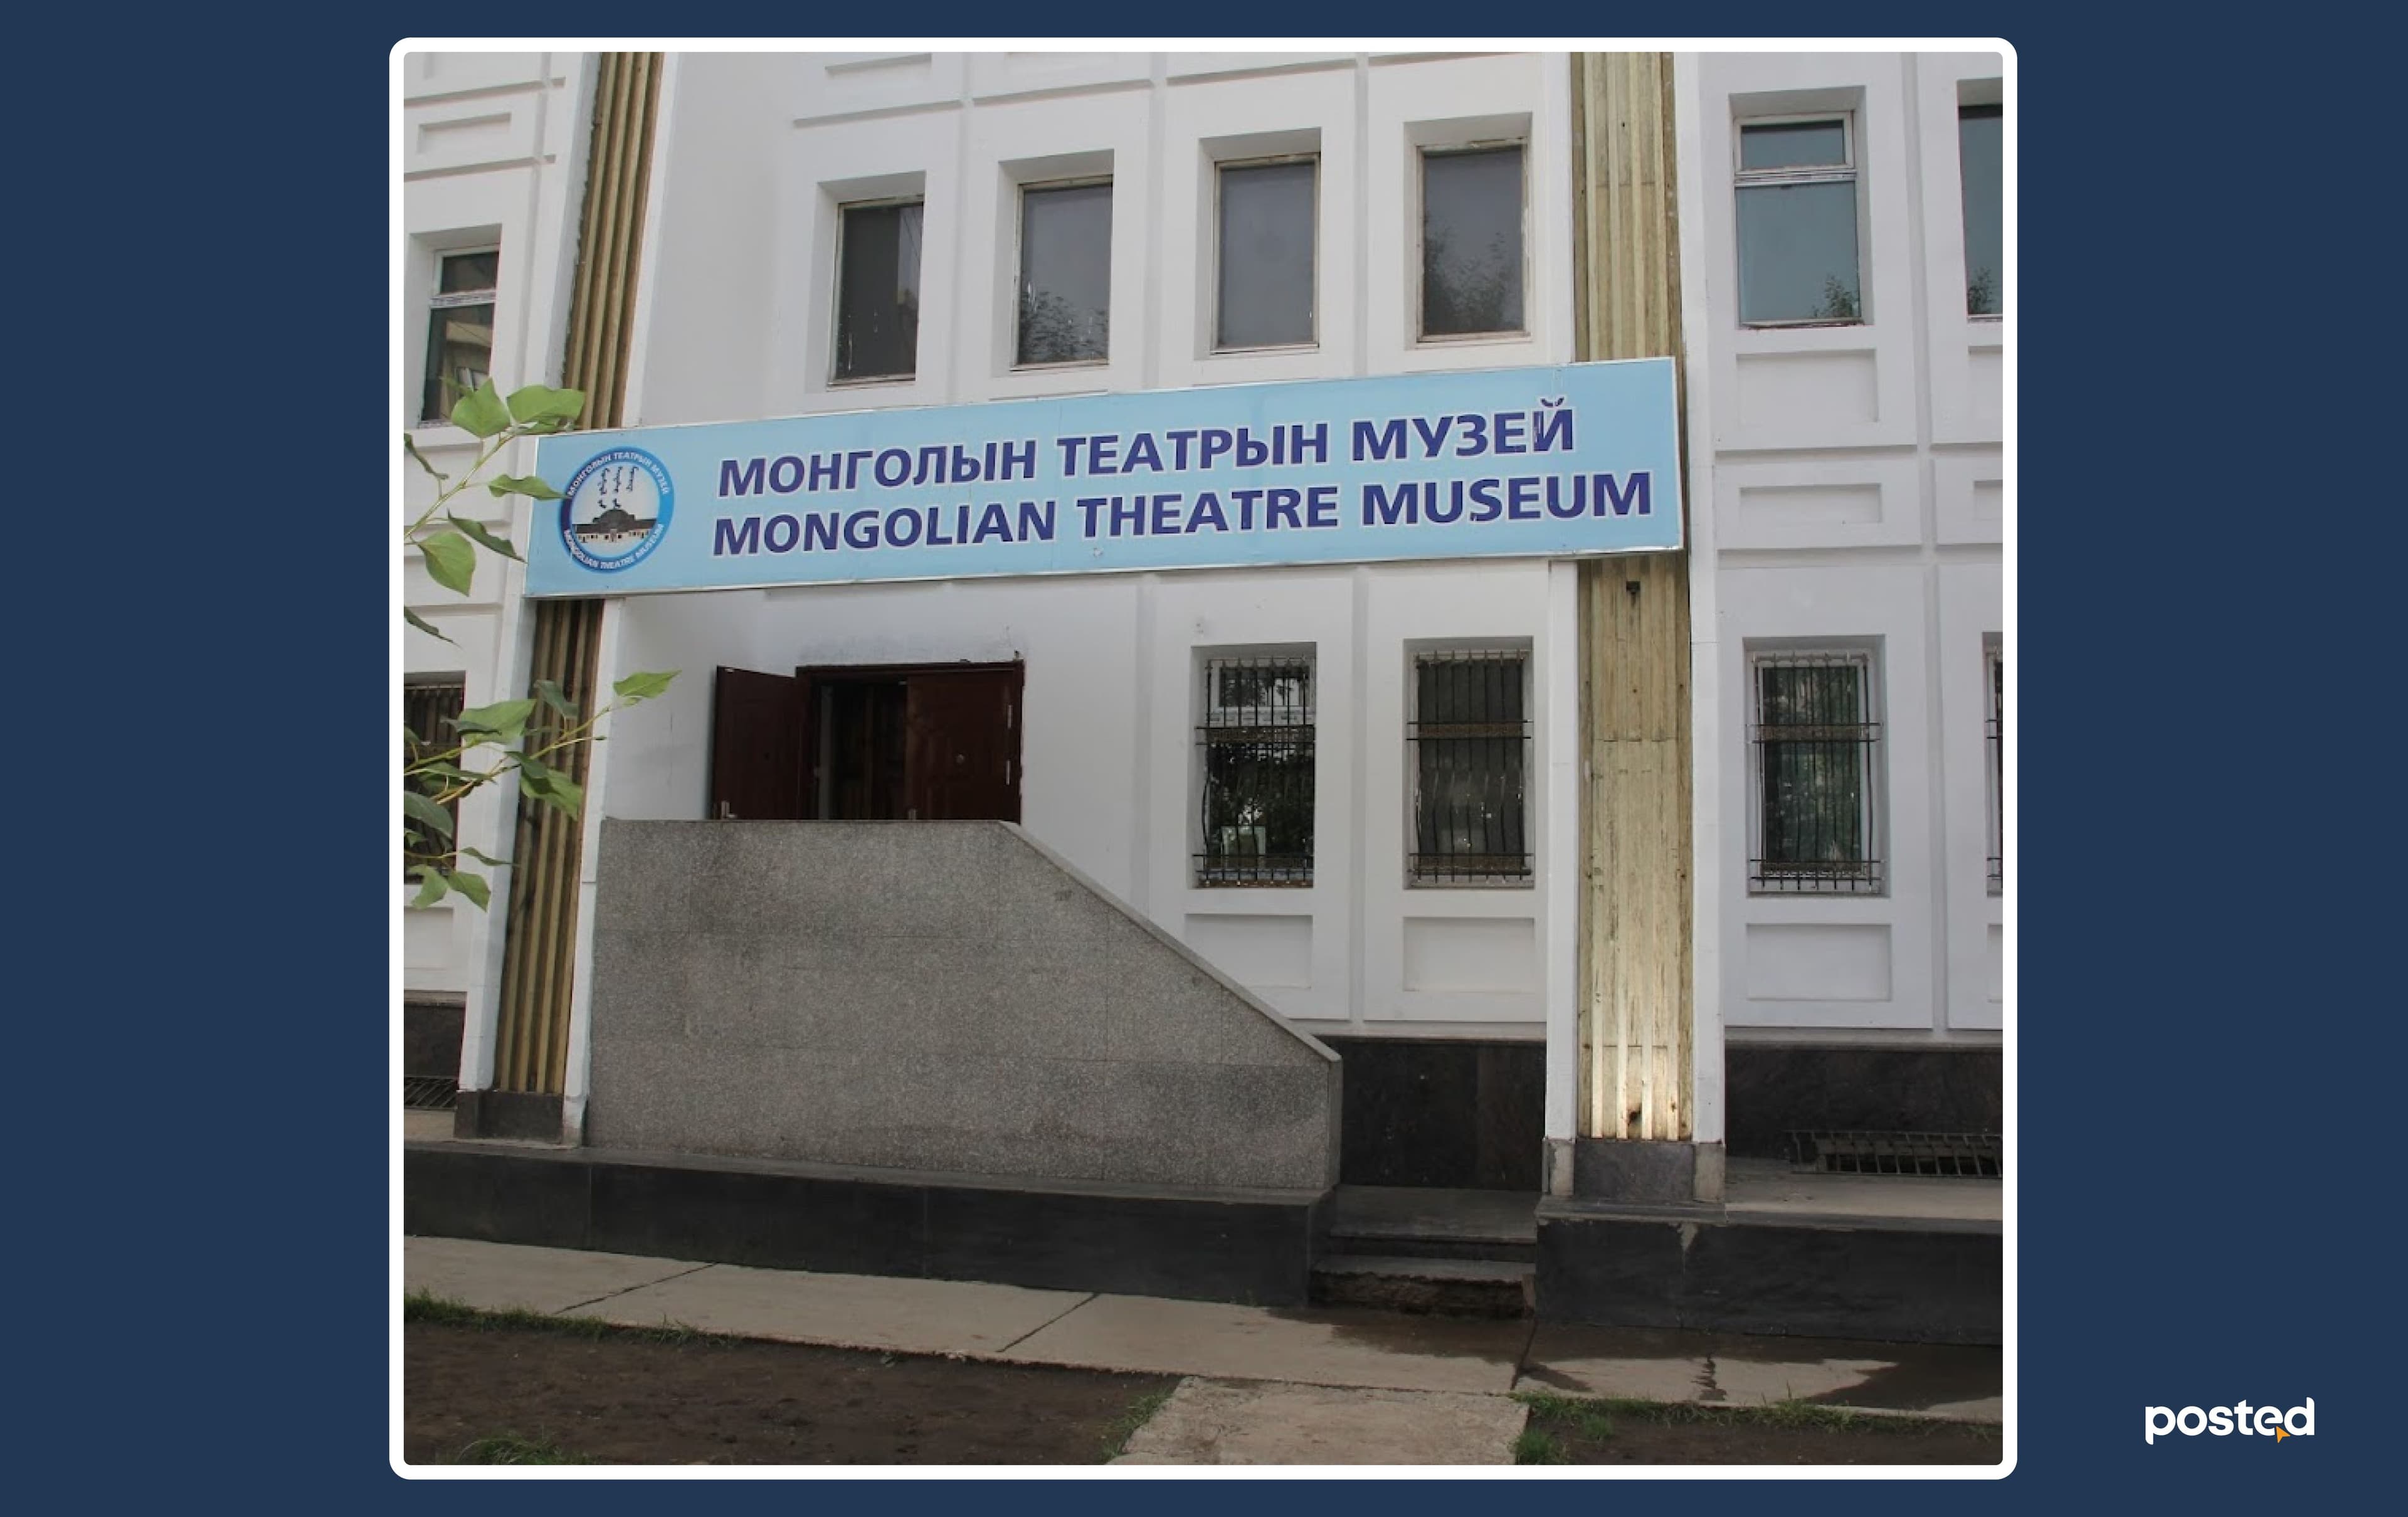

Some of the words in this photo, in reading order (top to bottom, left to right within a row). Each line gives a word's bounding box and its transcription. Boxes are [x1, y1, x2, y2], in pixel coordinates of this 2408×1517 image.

[720, 442, 1036, 496] МОНГОЛЫН
[1060, 423, 1328, 477] ТЕАТРЫН
[1353, 397, 1573, 462] МУЗЕЙ
[715, 500, 1055, 554] MONGOLIAN
[1077, 487, 1336, 538] THEATRE
[1363, 472, 1650, 526] MUSEUM
